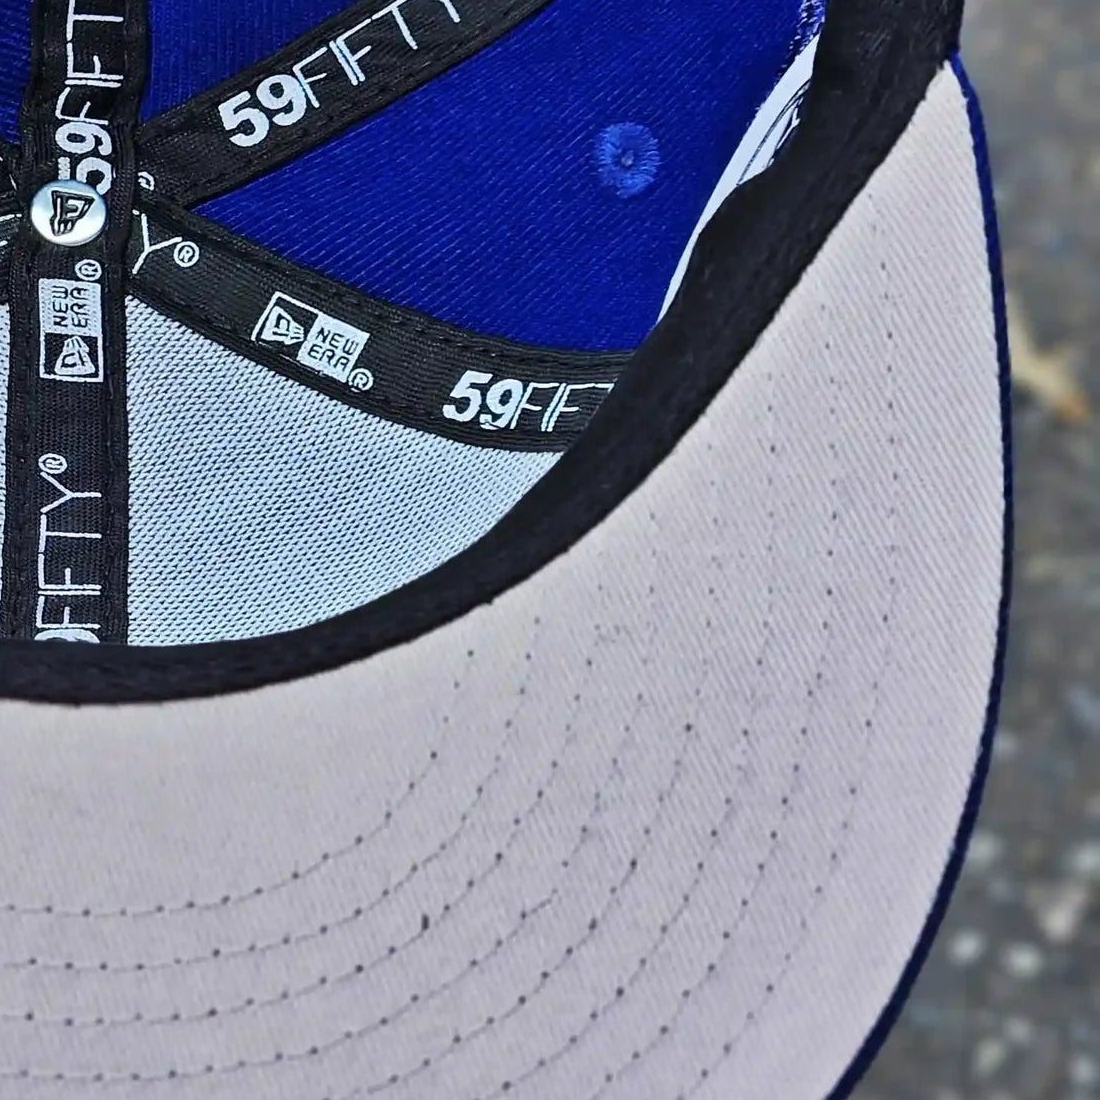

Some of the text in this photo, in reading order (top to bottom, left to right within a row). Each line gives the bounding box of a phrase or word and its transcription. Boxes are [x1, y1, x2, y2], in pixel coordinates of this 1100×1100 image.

[53, 286, 69, 327] NEW
[70, 288, 89, 328] ERA
[308, 344, 350, 372] ERA
[315, 327, 359, 356] NEW
[35, 471, 102, 644] FIFTY
